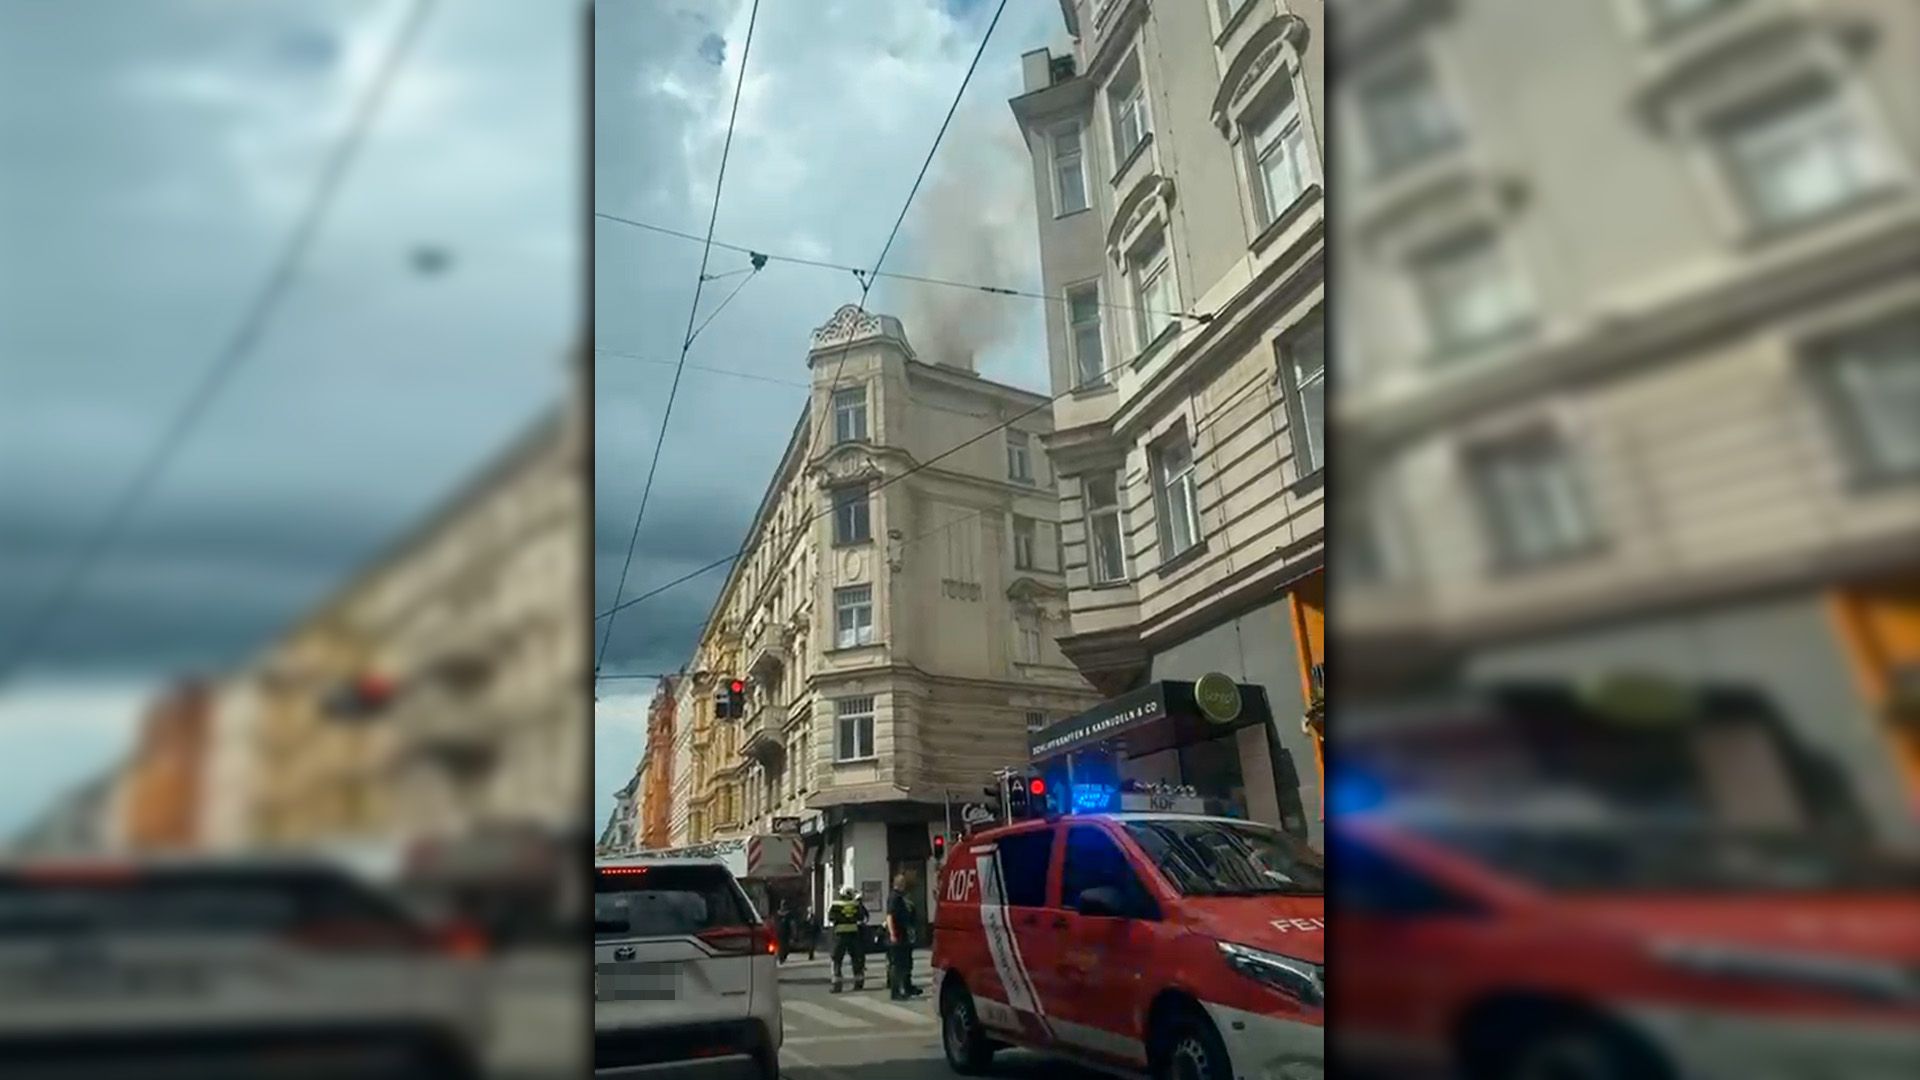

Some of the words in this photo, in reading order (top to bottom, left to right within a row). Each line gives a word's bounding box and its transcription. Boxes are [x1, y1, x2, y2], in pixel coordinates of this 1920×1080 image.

[1145, 701, 1157, 714] CO
[1150, 798, 1176, 810] KDF
[947, 869, 977, 901] KDF
